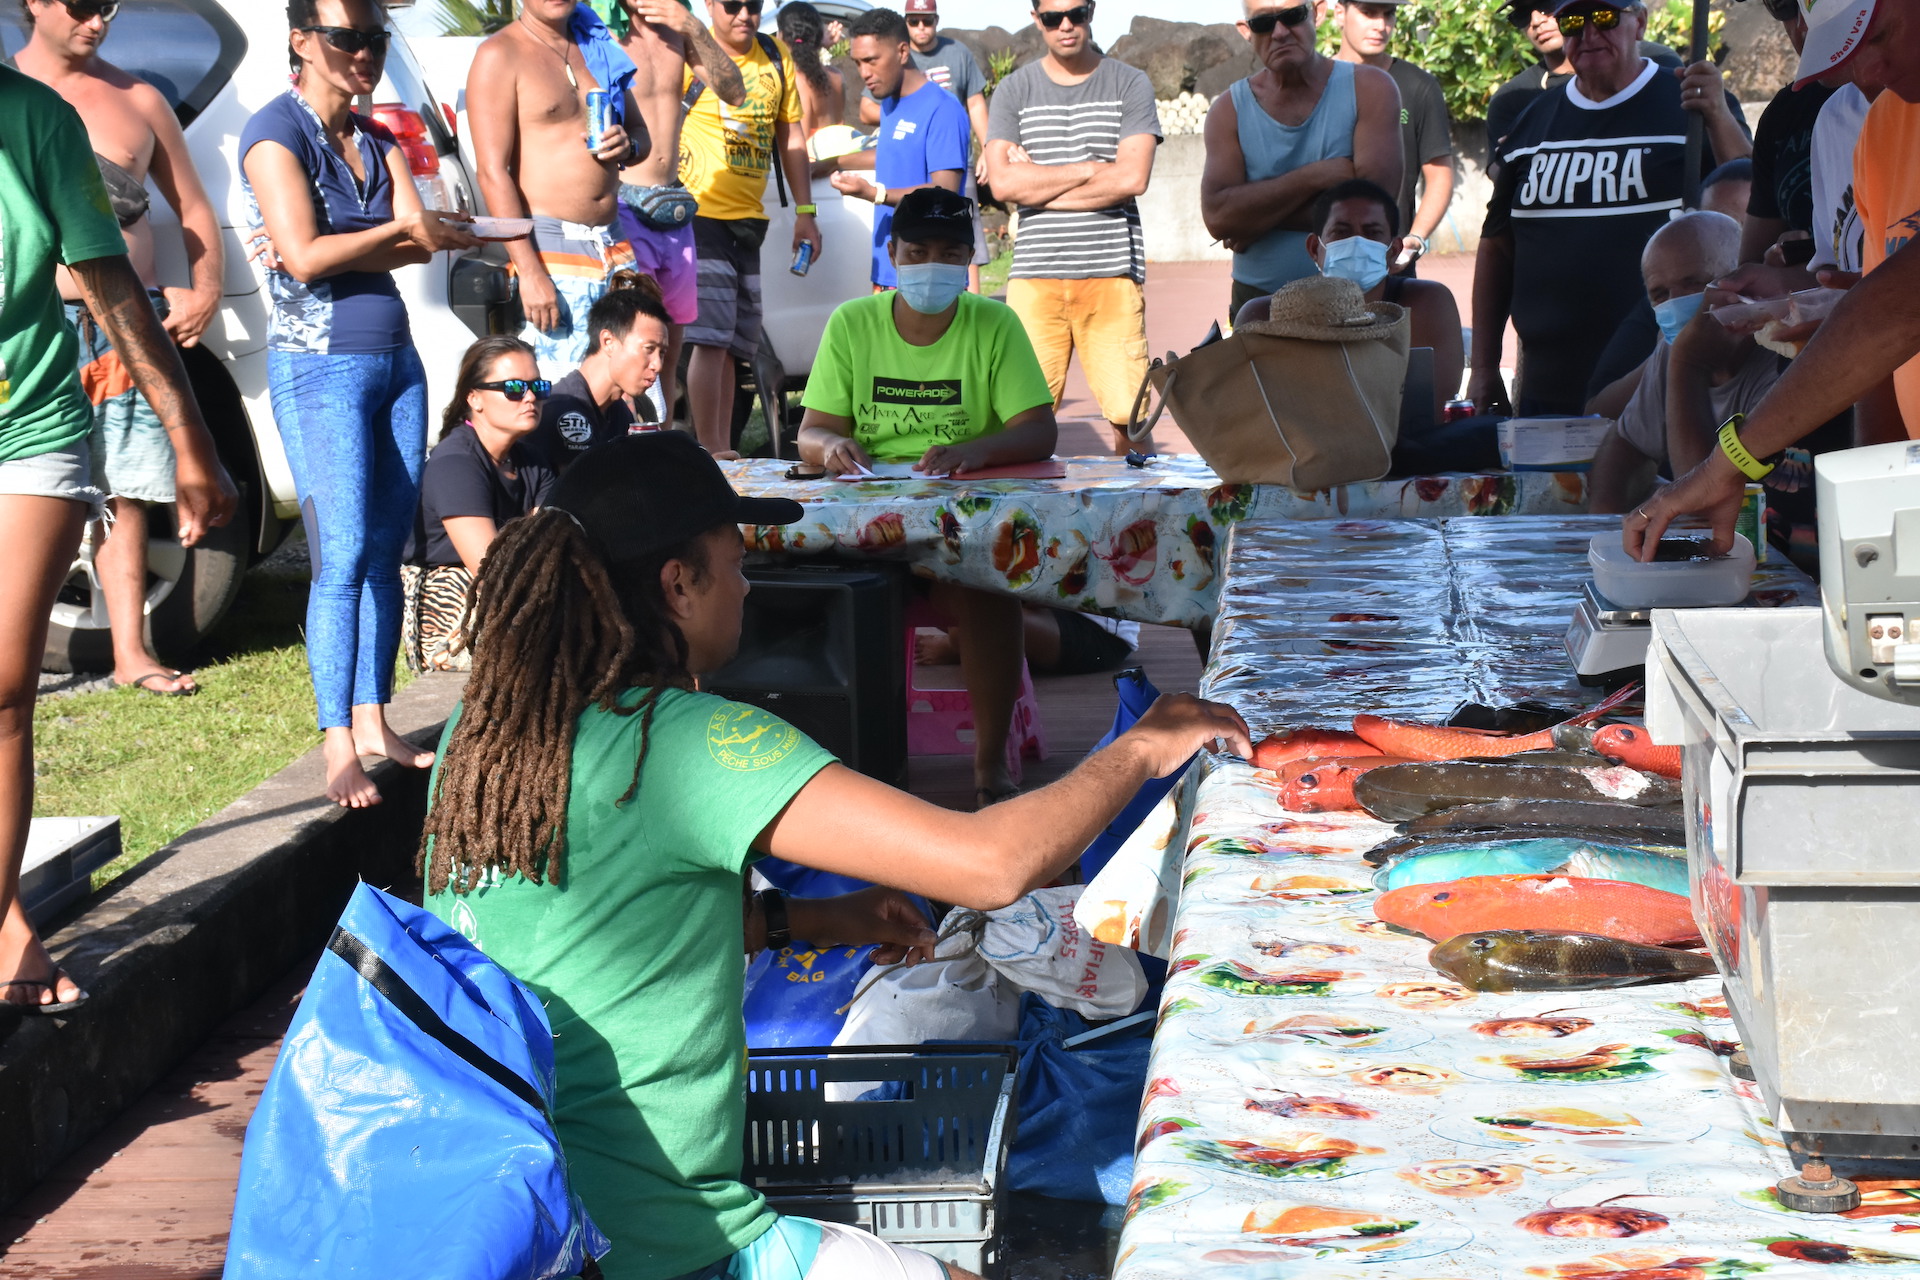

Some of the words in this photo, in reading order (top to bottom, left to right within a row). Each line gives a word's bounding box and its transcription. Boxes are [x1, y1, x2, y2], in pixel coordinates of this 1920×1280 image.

[1829, 38, 1854, 62] Shell
[1520, 148, 1649, 206] SUPRA
[876, 385, 950, 398] POWERADE
[559, 417, 589, 428] STH
[753, 750, 782, 767] SOUS
[786, 970, 825, 983] BAG
